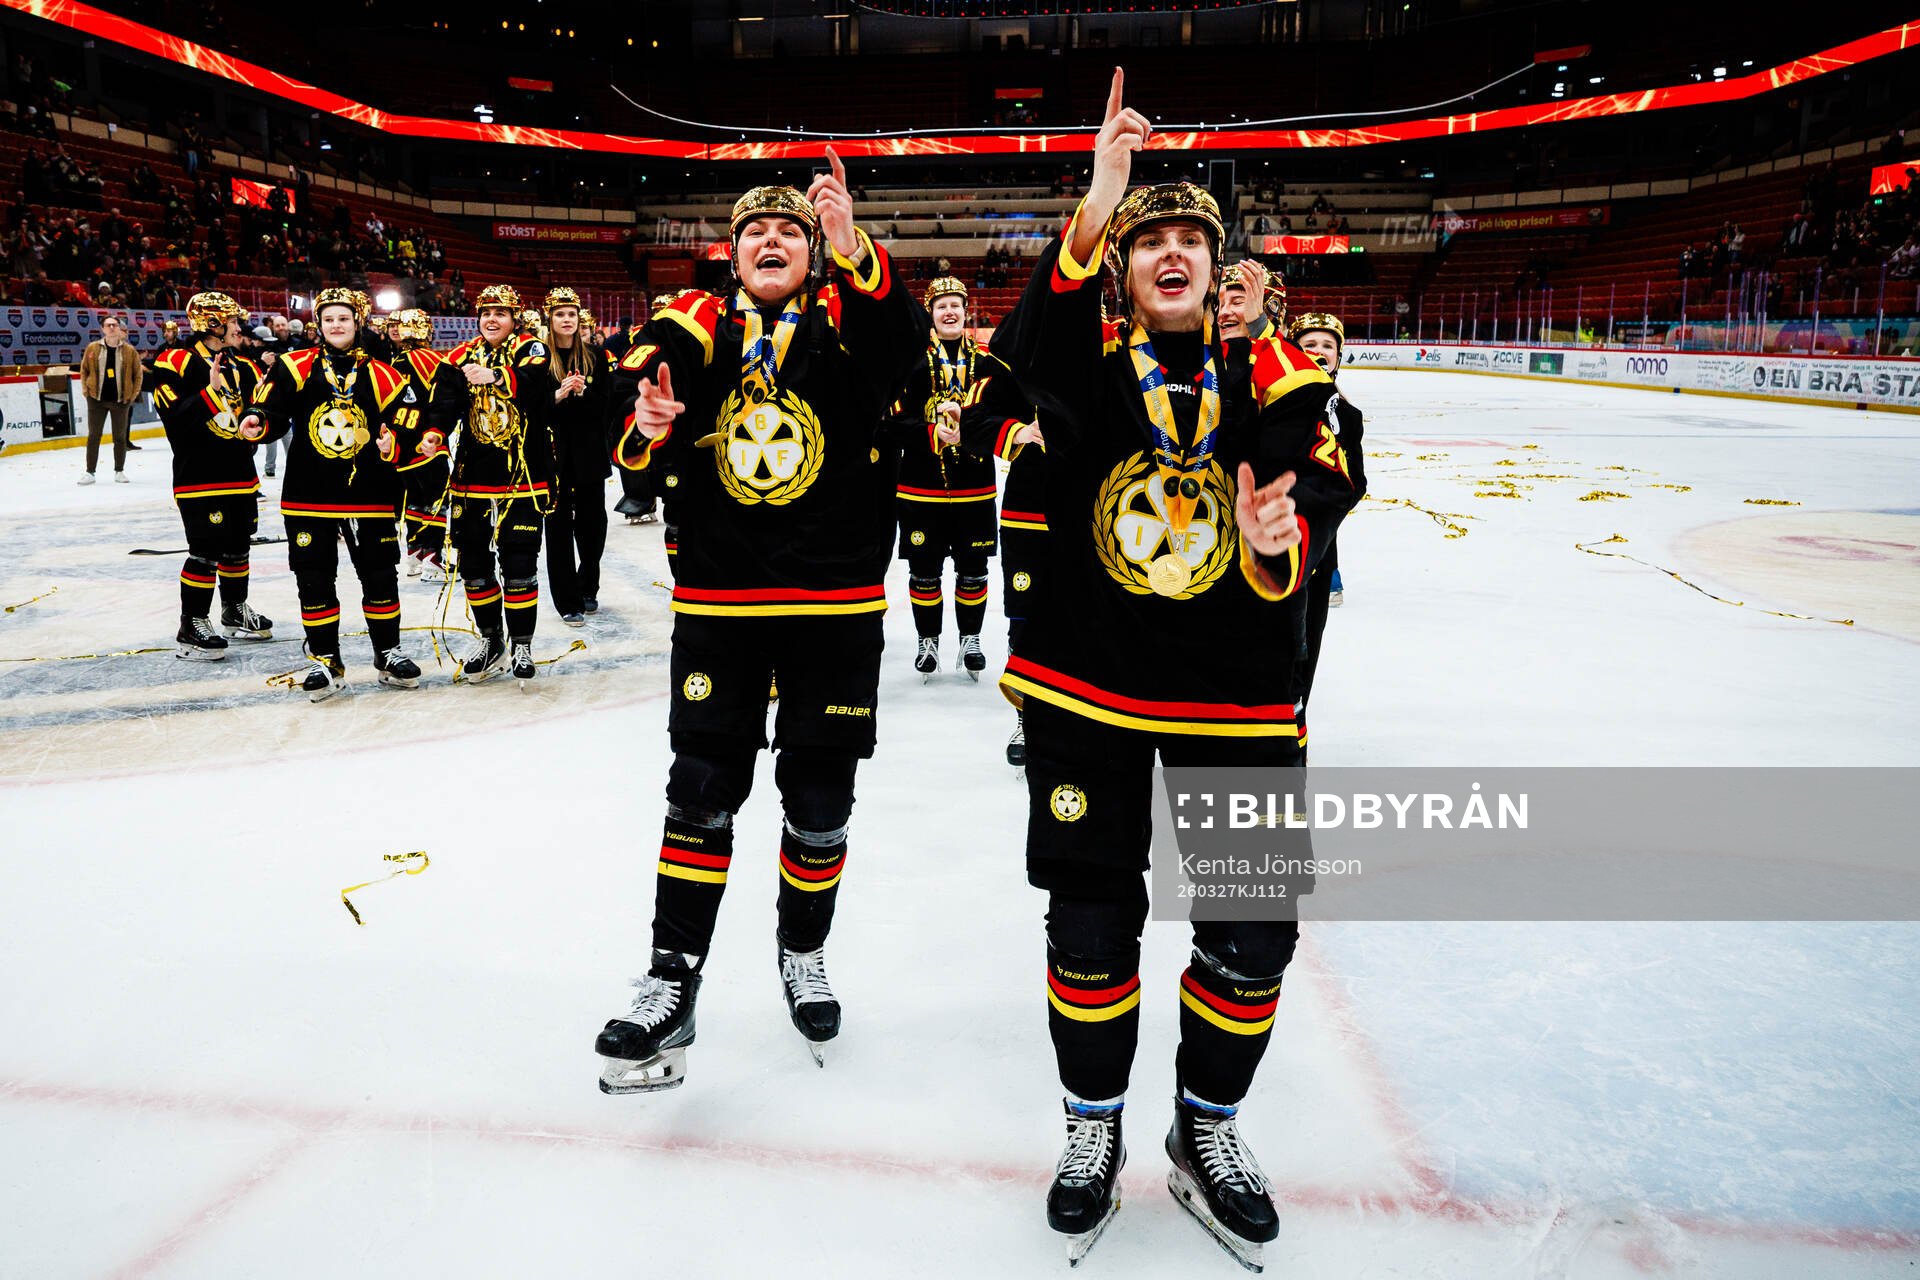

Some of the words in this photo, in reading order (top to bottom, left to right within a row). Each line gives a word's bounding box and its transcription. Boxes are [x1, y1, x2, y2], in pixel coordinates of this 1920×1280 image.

[1479, 217, 1493, 231] på
[498, 225, 536, 237] STÖRST
[537, 229, 549, 238] på
[550, 229, 569, 240] låga
[1379, 216, 1438, 247] ITEM
[1359, 351, 1399, 361] AWEA
[1426, 349, 1441, 362] elis
[1455, 352, 1466, 365] JT
[1499, 351, 1523, 364] CCVE
[1627, 357, 1668, 376] nomo
[1770, 368, 1801, 389] EN
[1809, 370, 1863, 394] BRA
[6, 420, 43, 430] FACILITY
[393, 407, 420, 430] 98
[755, 414, 767, 430] B
[825, 705, 872, 718] BAUER
[669, 833, 704, 845] BAUER
[807, 854, 840, 864] BAUER
[1063, 971, 1109, 981] BAUER
[1243, 983, 1280, 998] BAUER
